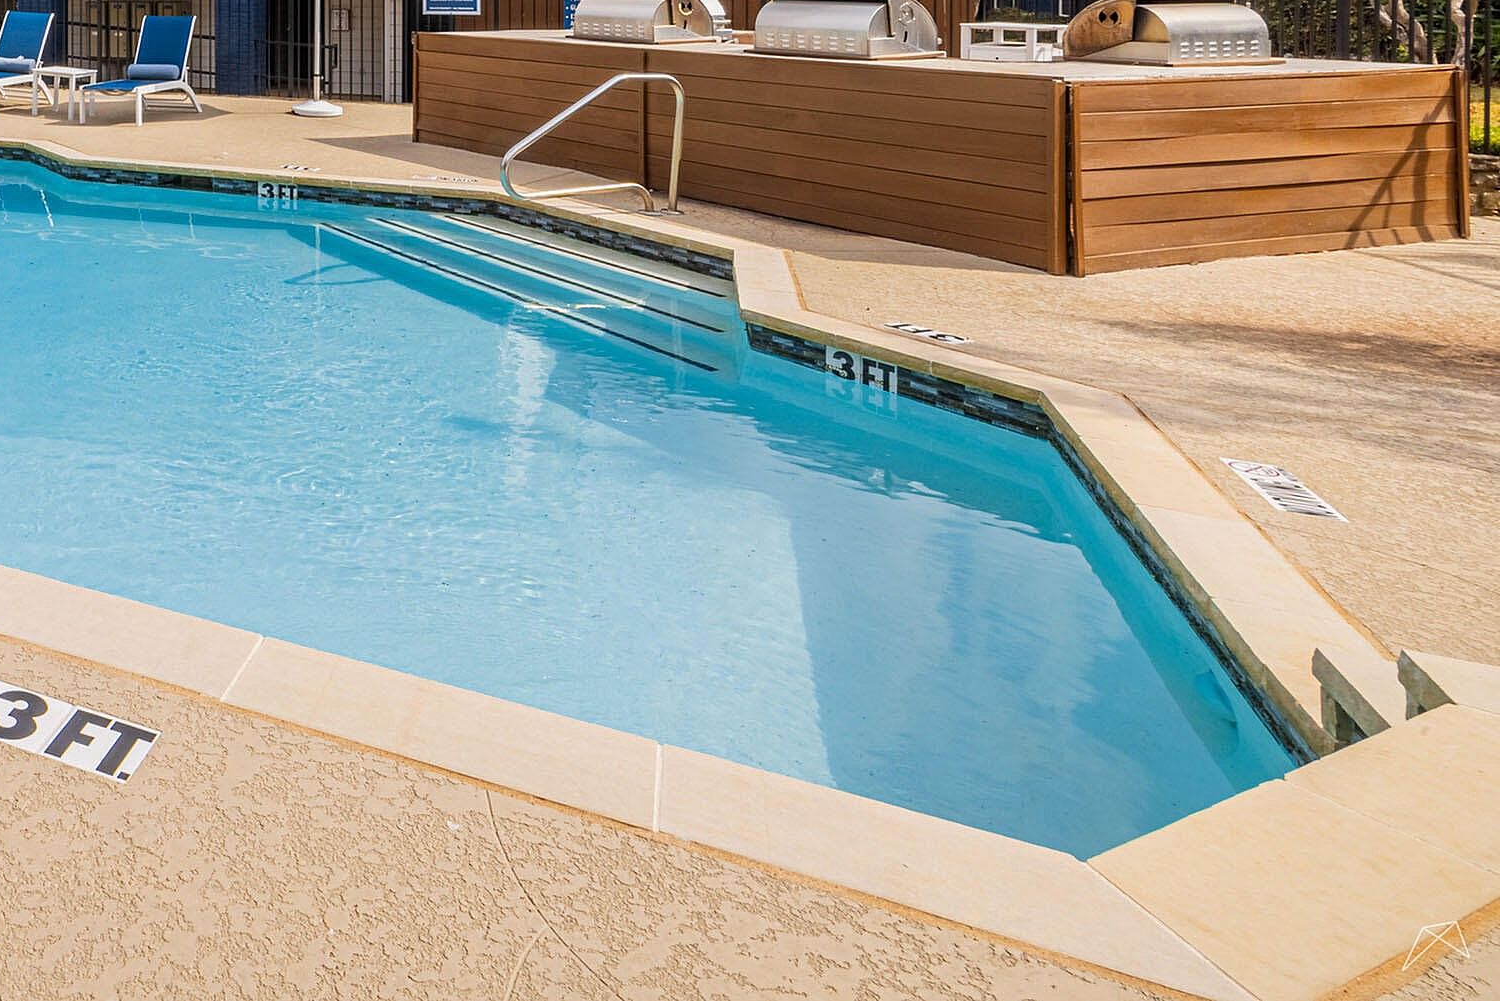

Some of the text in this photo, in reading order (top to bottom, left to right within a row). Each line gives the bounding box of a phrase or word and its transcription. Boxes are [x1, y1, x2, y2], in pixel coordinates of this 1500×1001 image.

[260, 182, 297, 200] 3 FT
[828, 350, 896, 393] 3 FT
